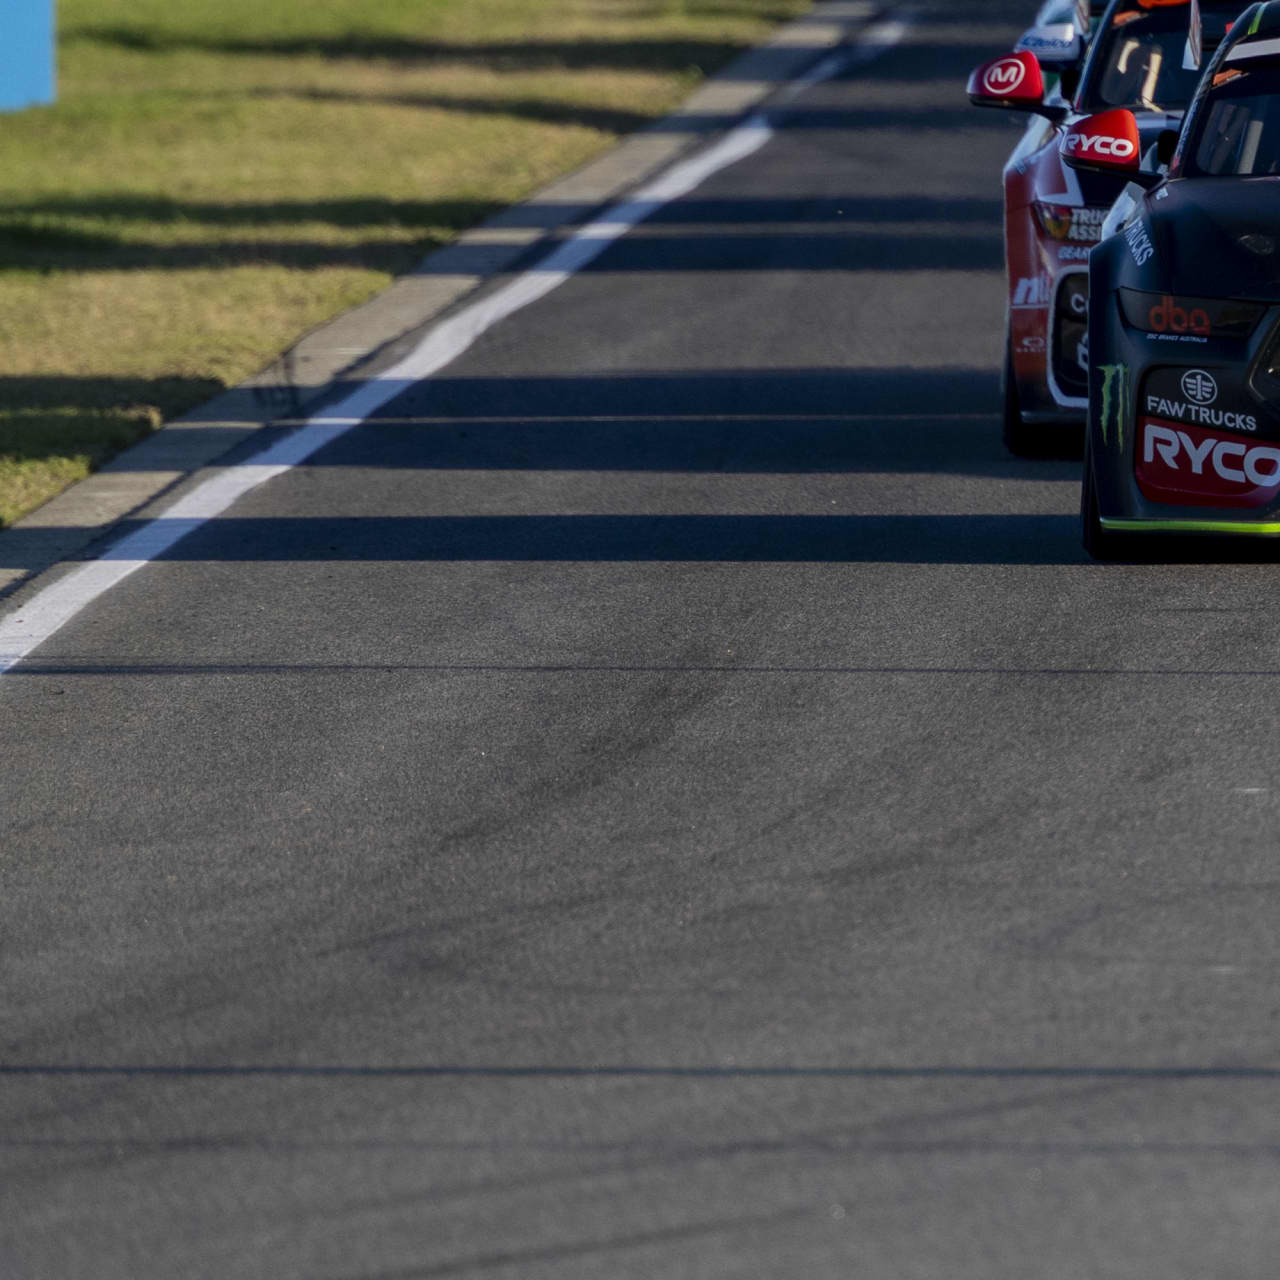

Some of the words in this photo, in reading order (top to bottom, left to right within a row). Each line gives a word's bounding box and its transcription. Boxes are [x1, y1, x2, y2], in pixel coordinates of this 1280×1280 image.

[1063, 132, 1135, 158] RYCO
[1149, 295, 1211, 337] dba
[1147, 395, 1189, 419] FAW
[1189, 406, 1257, 432] TRUCKS
